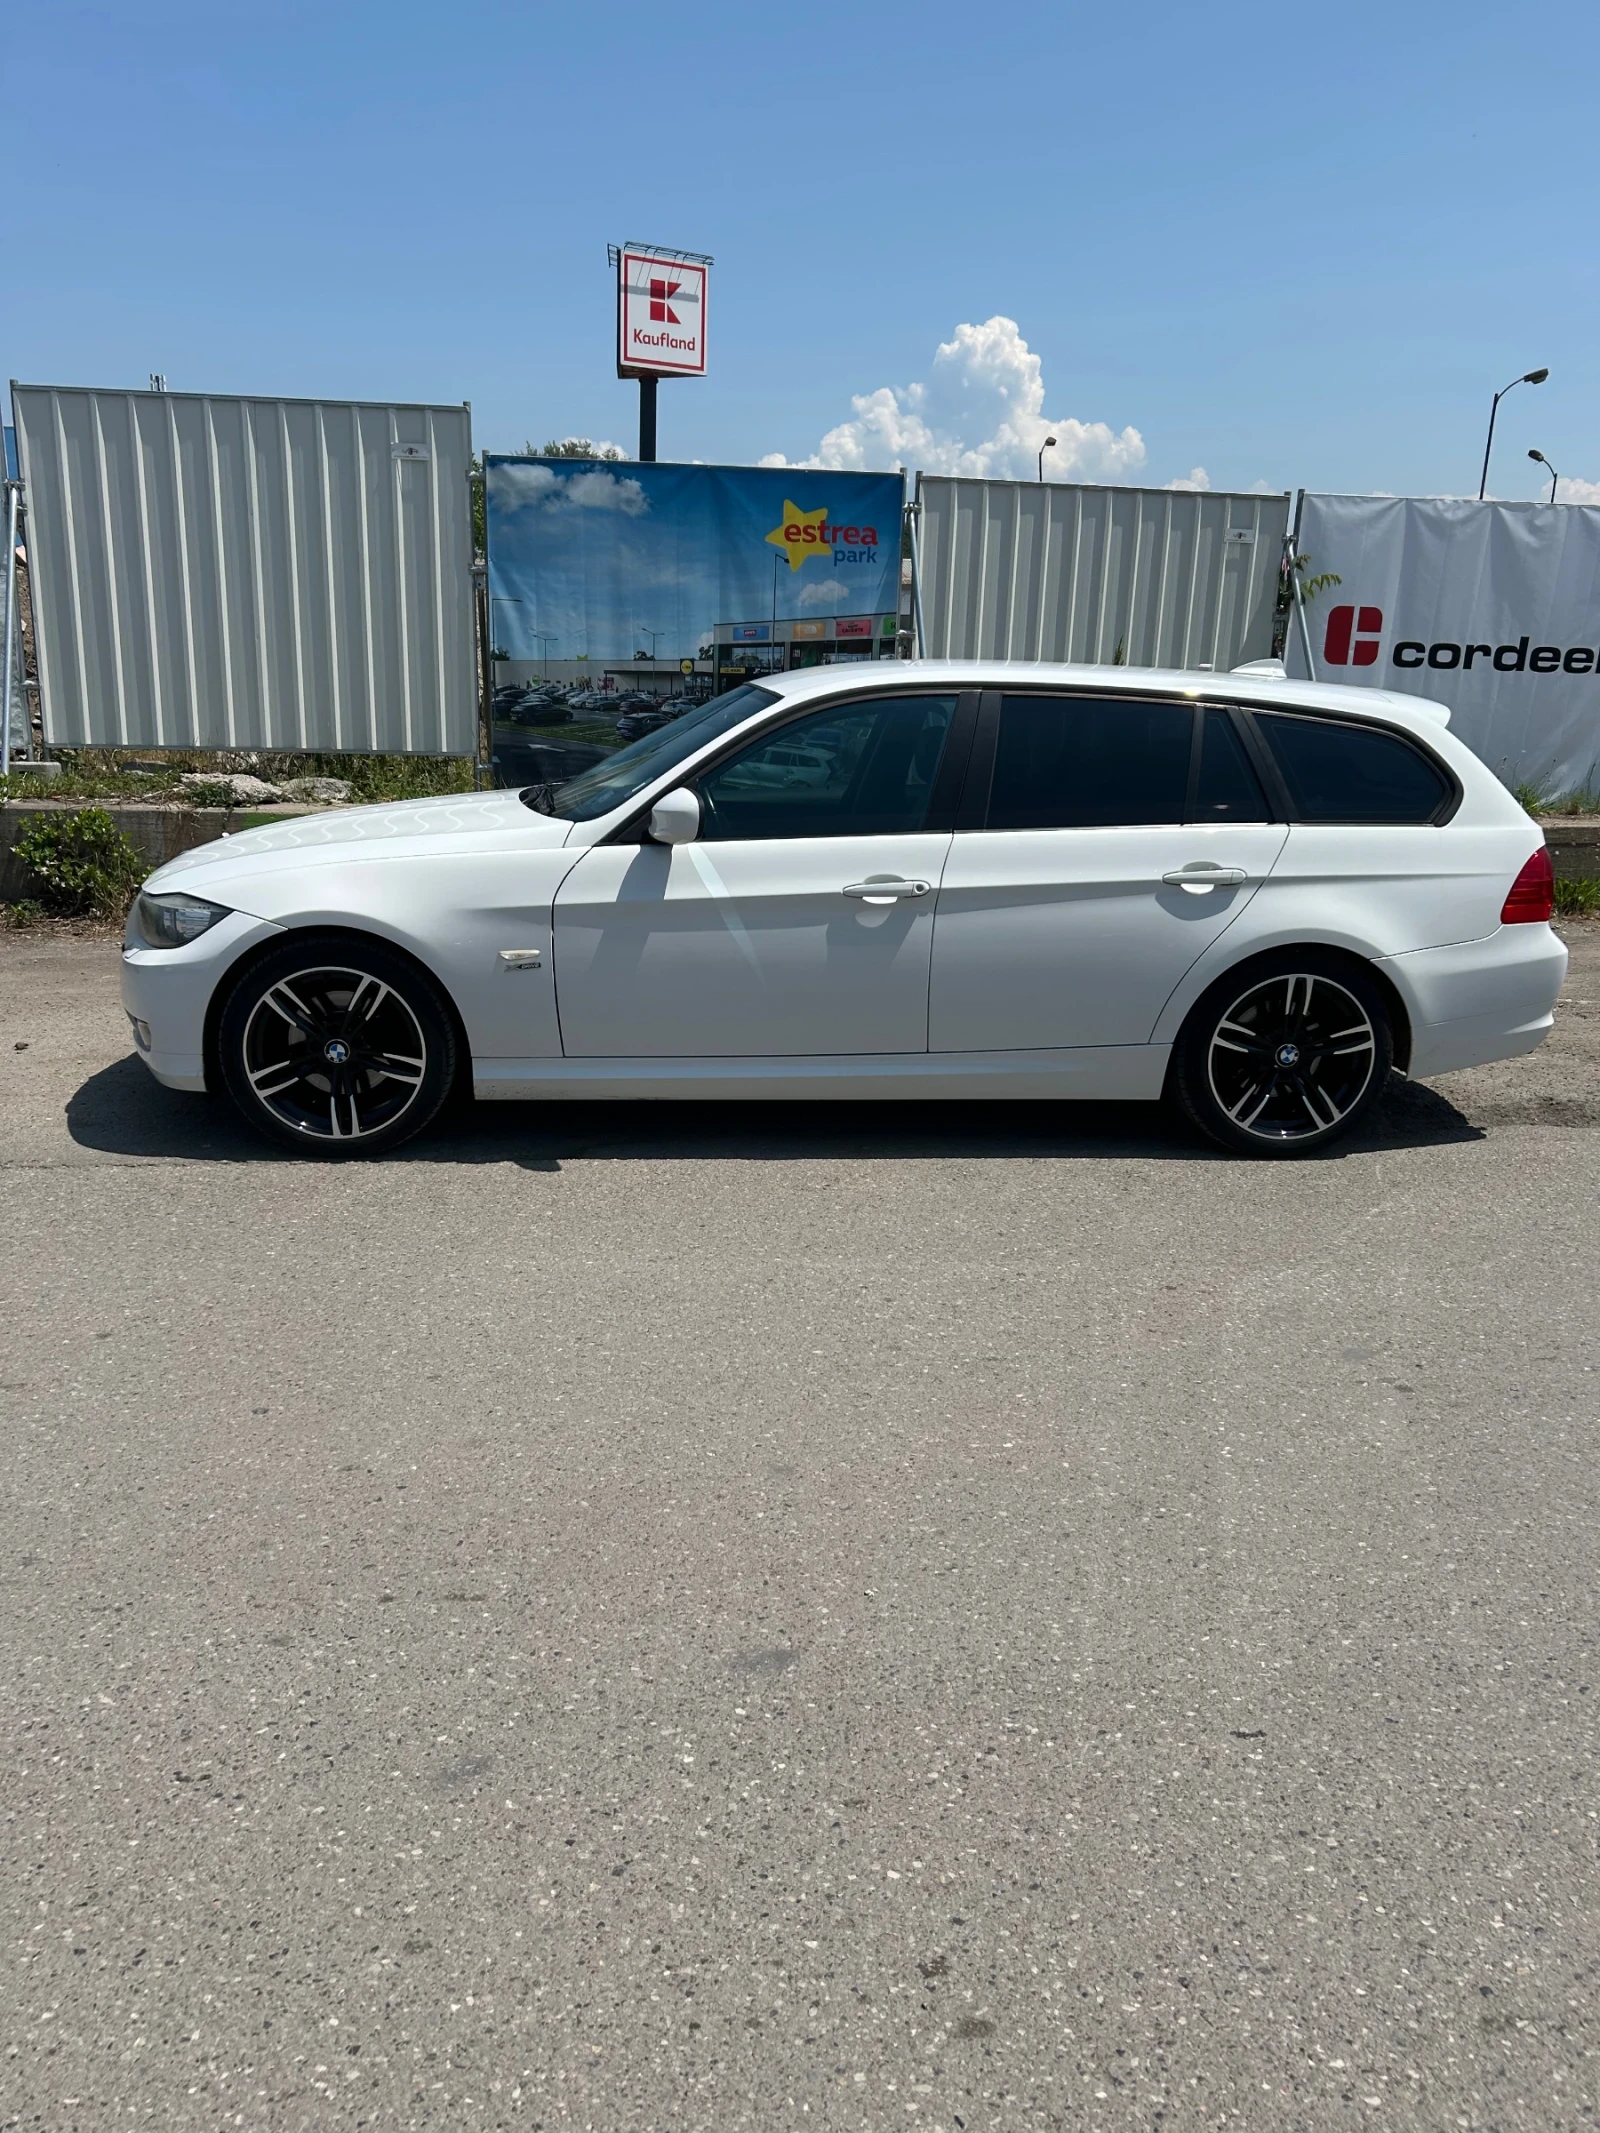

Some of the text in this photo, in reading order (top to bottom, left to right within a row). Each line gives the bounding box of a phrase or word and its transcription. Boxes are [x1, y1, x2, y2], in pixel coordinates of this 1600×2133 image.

[634, 328, 696, 351] Kaufland
[783, 519, 878, 546] estrea
[834, 547, 877, 567] park
[1392, 636, 1600, 674] cordee
